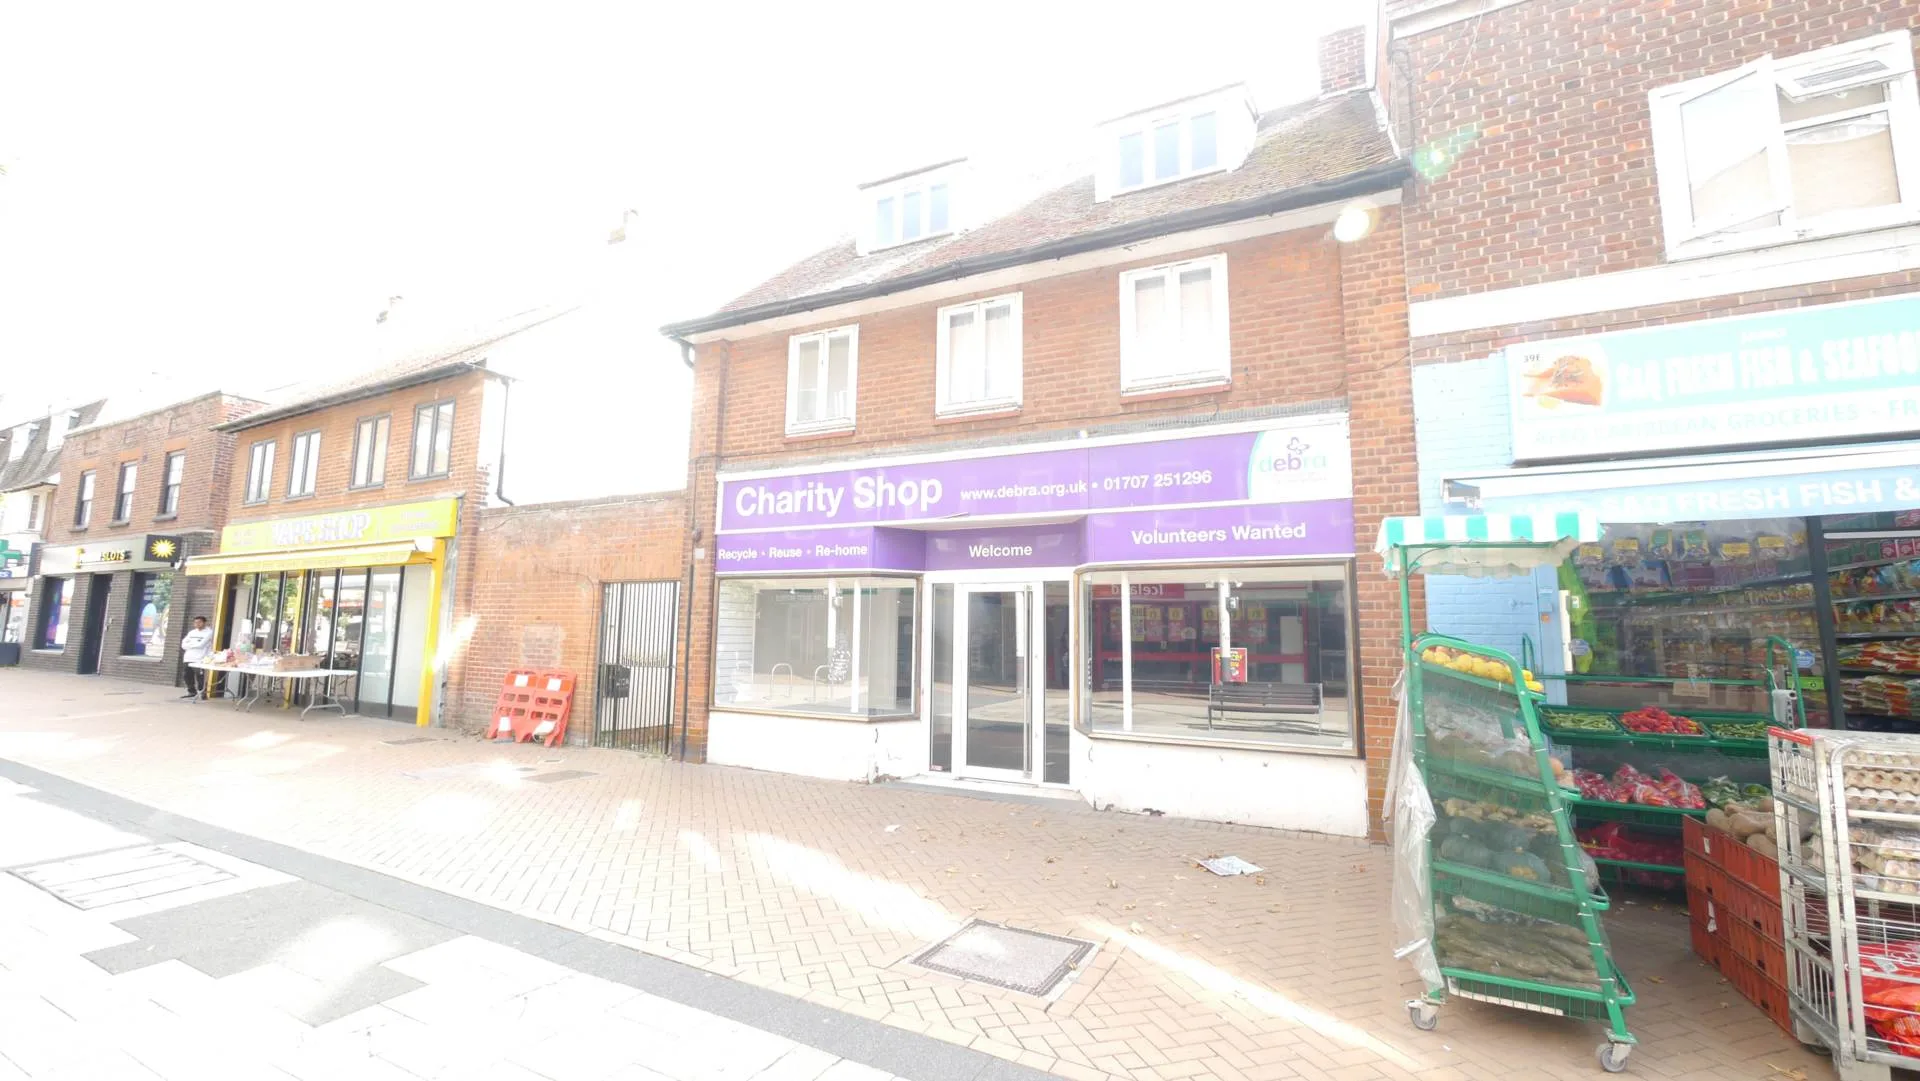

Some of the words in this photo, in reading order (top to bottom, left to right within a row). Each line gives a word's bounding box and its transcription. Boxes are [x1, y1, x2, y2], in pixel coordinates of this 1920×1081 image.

[1739, 345, 1795, 390] FISH
[1822, 328, 1920, 382] SEAFOO
[1728, 402, 1860, 430] GROCERIES
[1256, 452, 1327, 473] debra
[735, 480, 844, 518] Charity
[853, 475, 944, 512] Shop
[960, 479, 1087, 501] www.debra.org.uk
[1104, 475, 1149, 492] 01707
[1154, 470, 1213, 488] 251296
[1677, 487, 1790, 514] FRESH
[1801, 480, 1882, 507] FISH
[1895, 477, 1920, 501] &
[1131, 524, 1227, 546] Volunteers
[1232, 522, 1307, 542] Wanted
[718, 547, 758, 562] Recycle
[768, 546, 802, 559] Reuse
[815, 543, 868, 558] Re-home
[968, 544, 1033, 558] Welcome
